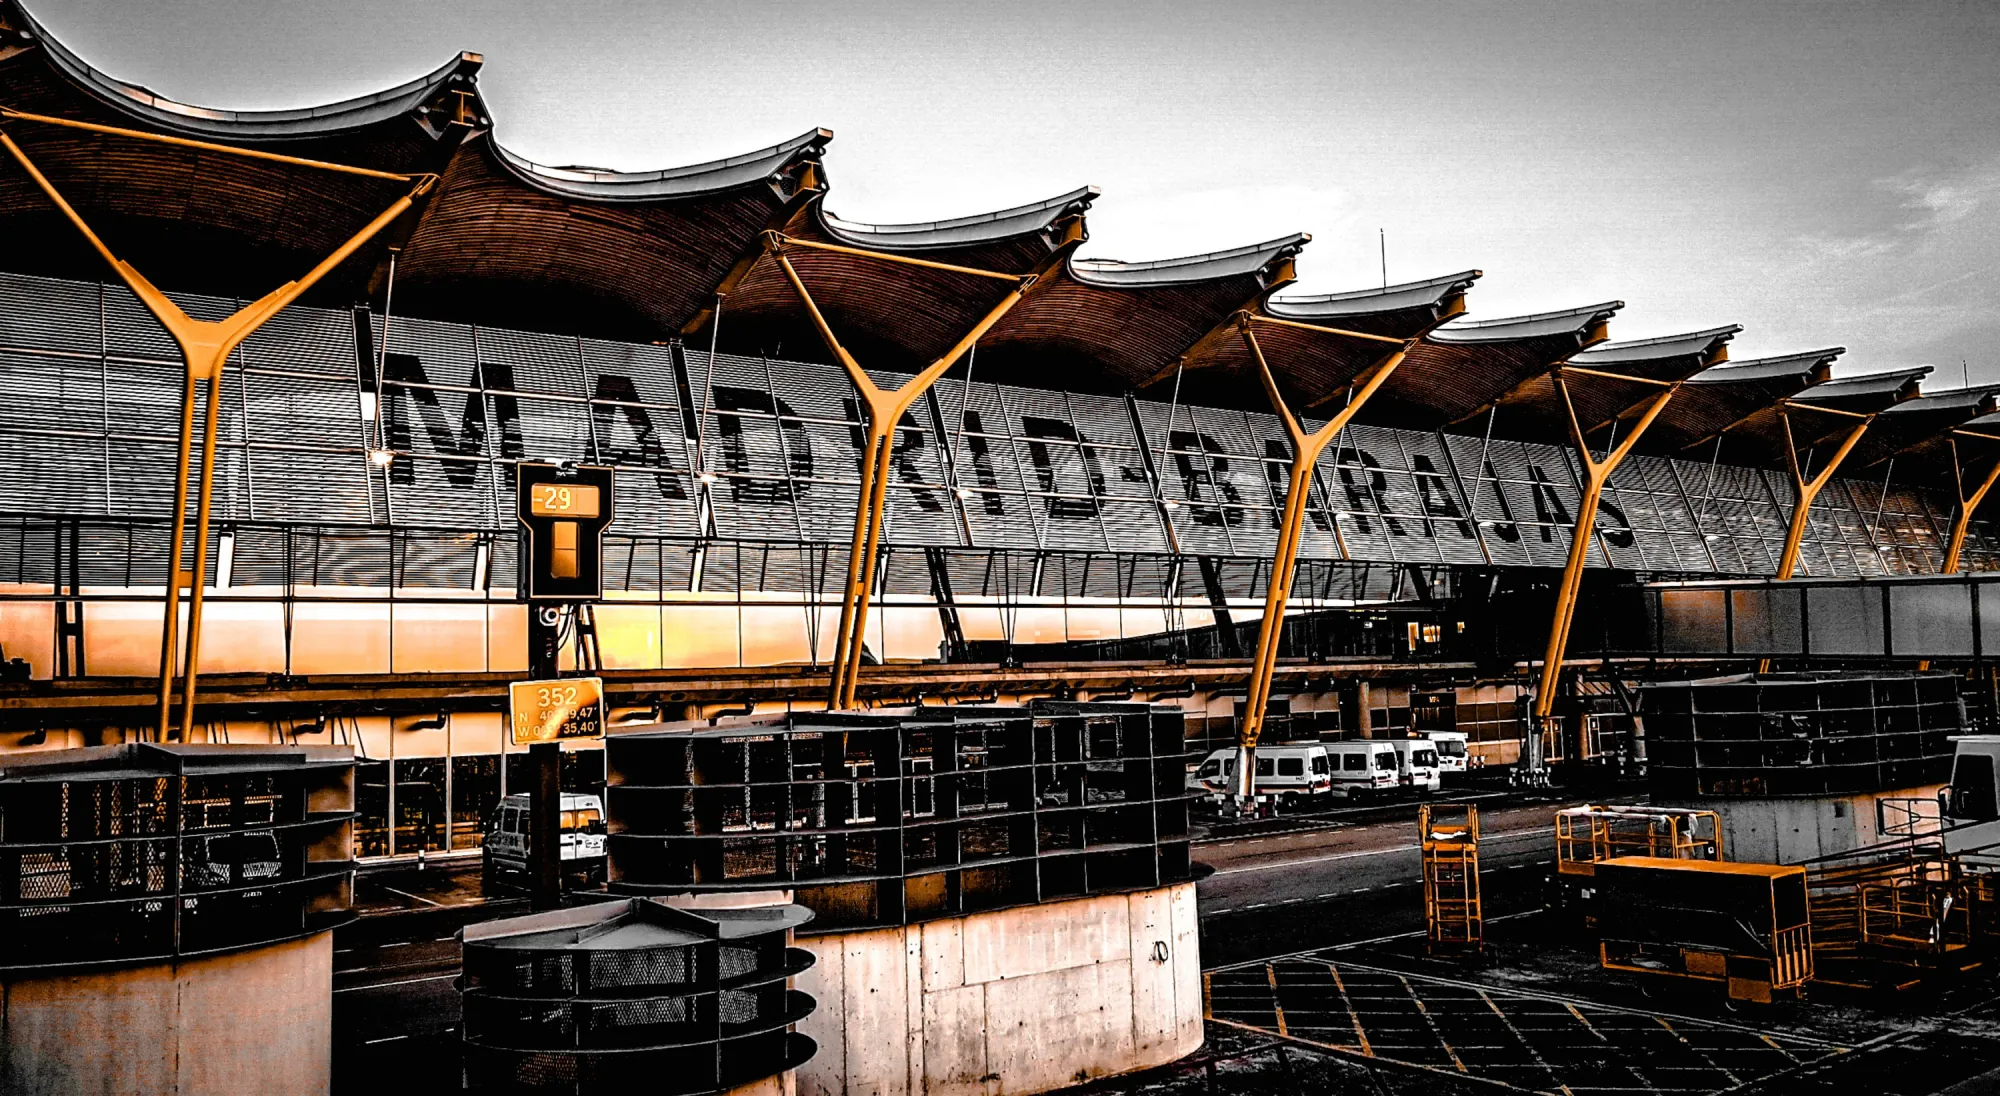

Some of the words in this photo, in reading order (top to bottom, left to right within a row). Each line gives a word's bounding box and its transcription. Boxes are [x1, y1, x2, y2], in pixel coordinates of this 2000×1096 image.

[538, 687, 577, 707] 352
[519, 712, 529, 722] N
[518, 726, 530, 737] W
